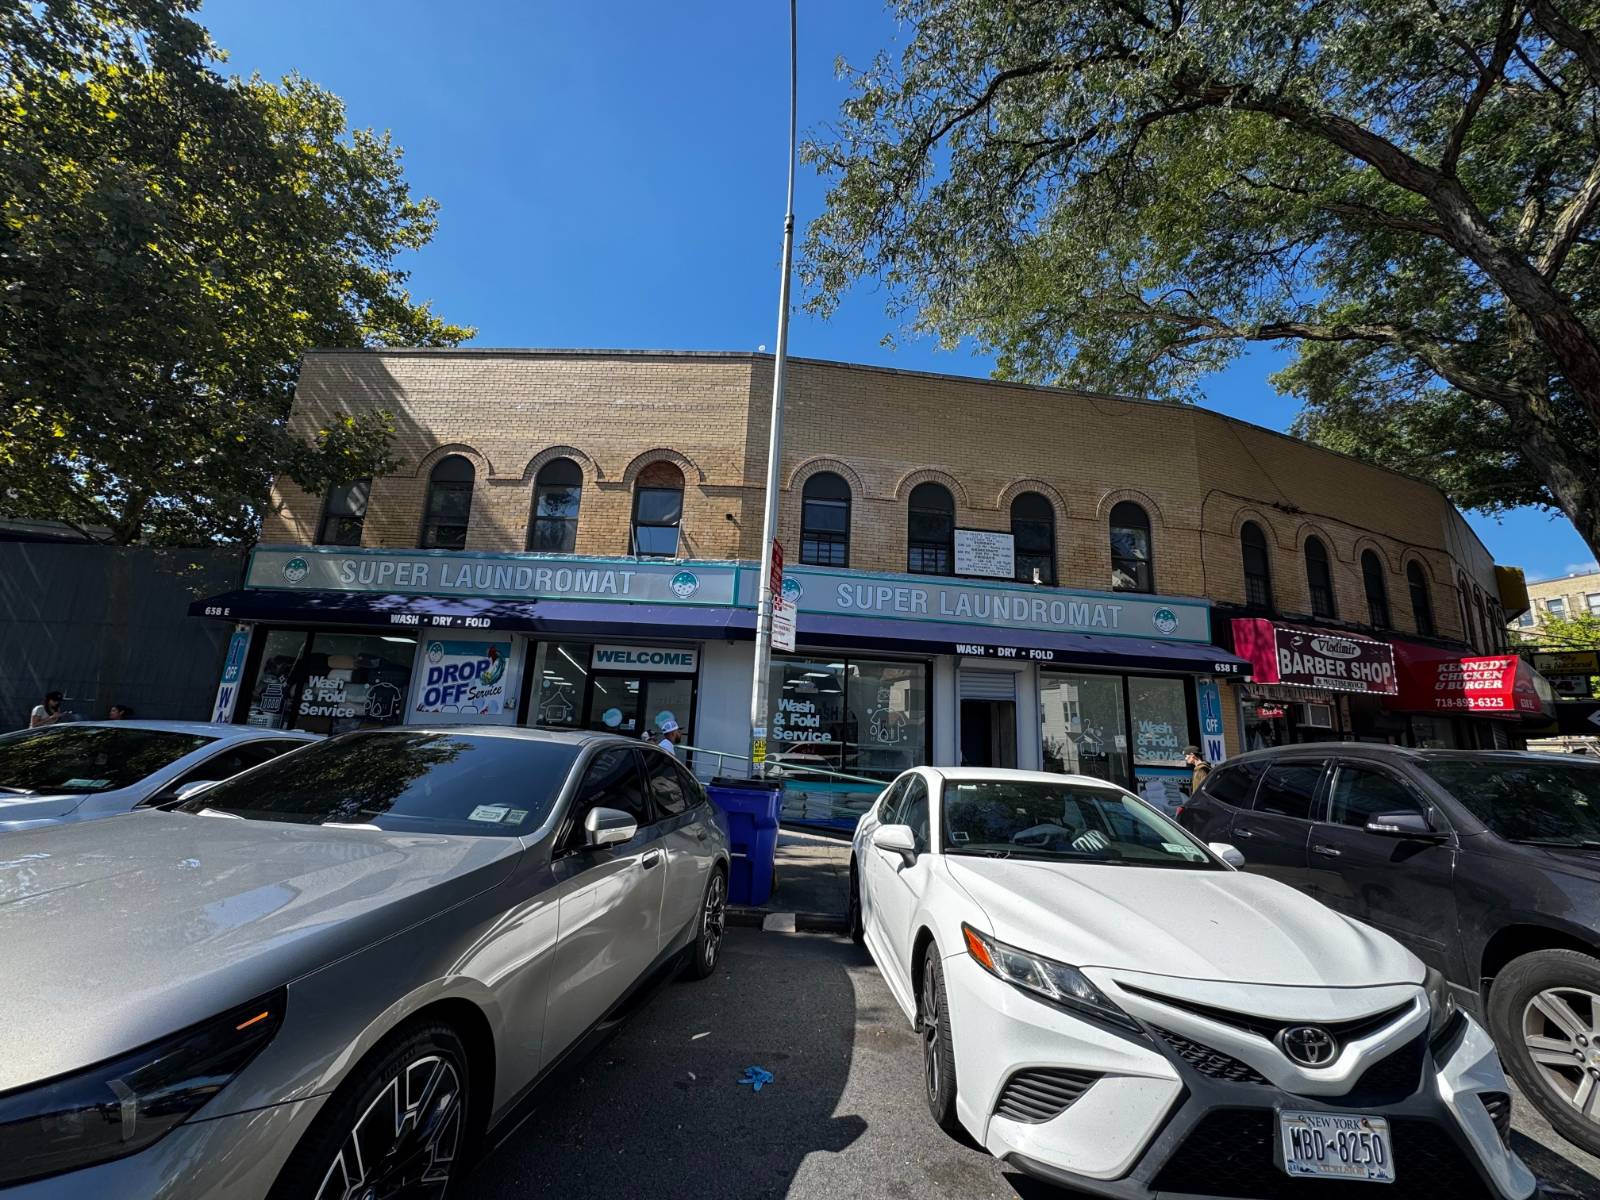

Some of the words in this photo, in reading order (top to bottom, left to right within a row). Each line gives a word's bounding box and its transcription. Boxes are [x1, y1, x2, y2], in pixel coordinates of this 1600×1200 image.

[340, 559, 428, 587] SUPER
[439, 563, 636, 594] LAUNDROMAT
[224, 607, 230, 616] E
[836, 582, 928, 614] SUPER
[940, 590, 1122, 629] LAUNDROMAT
[390, 614, 419, 625] WASH
[432, 616, 453, 627] DRY
[465, 617, 491, 628] FOLD
[596, 650, 693, 666] WELCOME
[956, 644, 984, 656] WASH
[997, 646, 1017, 658] DRY
[1030, 649, 1054, 660] FOLD
[427, 659, 491, 686] DROP
[1232, 664, 1238, 673] E
[1279, 647, 1348, 677] BARBER
[1350, 661, 1392, 685] SHOP
[1437, 659, 1513, 673] KENNEDY
[309, 675, 345, 689] Wash
[1439, 670, 1504, 682] CHICKEN
[1434, 682, 1445, 690] &
[1447, 680, 1503, 690] BURGER
[302, 688, 313, 701] &
[317, 690, 347, 703] Fold
[424, 682, 469, 707] OFF
[467, 686, 502, 701] Service
[299, 702, 355, 717] Service
[778, 698, 815, 713] Wash
[1435, 697, 1504, 708] 718-893-6325
[773, 713, 785, 725] &
[790, 713, 820, 728] Fold
[1138, 720, 1172, 733] Wash
[1206, 719, 1218, 732] OFF
[773, 727, 832, 742] Service
[1151, 734, 1178, 747] Fold
[1072, 830, 1109, 852] FDNY
[1307, 1116, 1331, 1128] NEW
[1333, 1118, 1361, 1130] YORK
